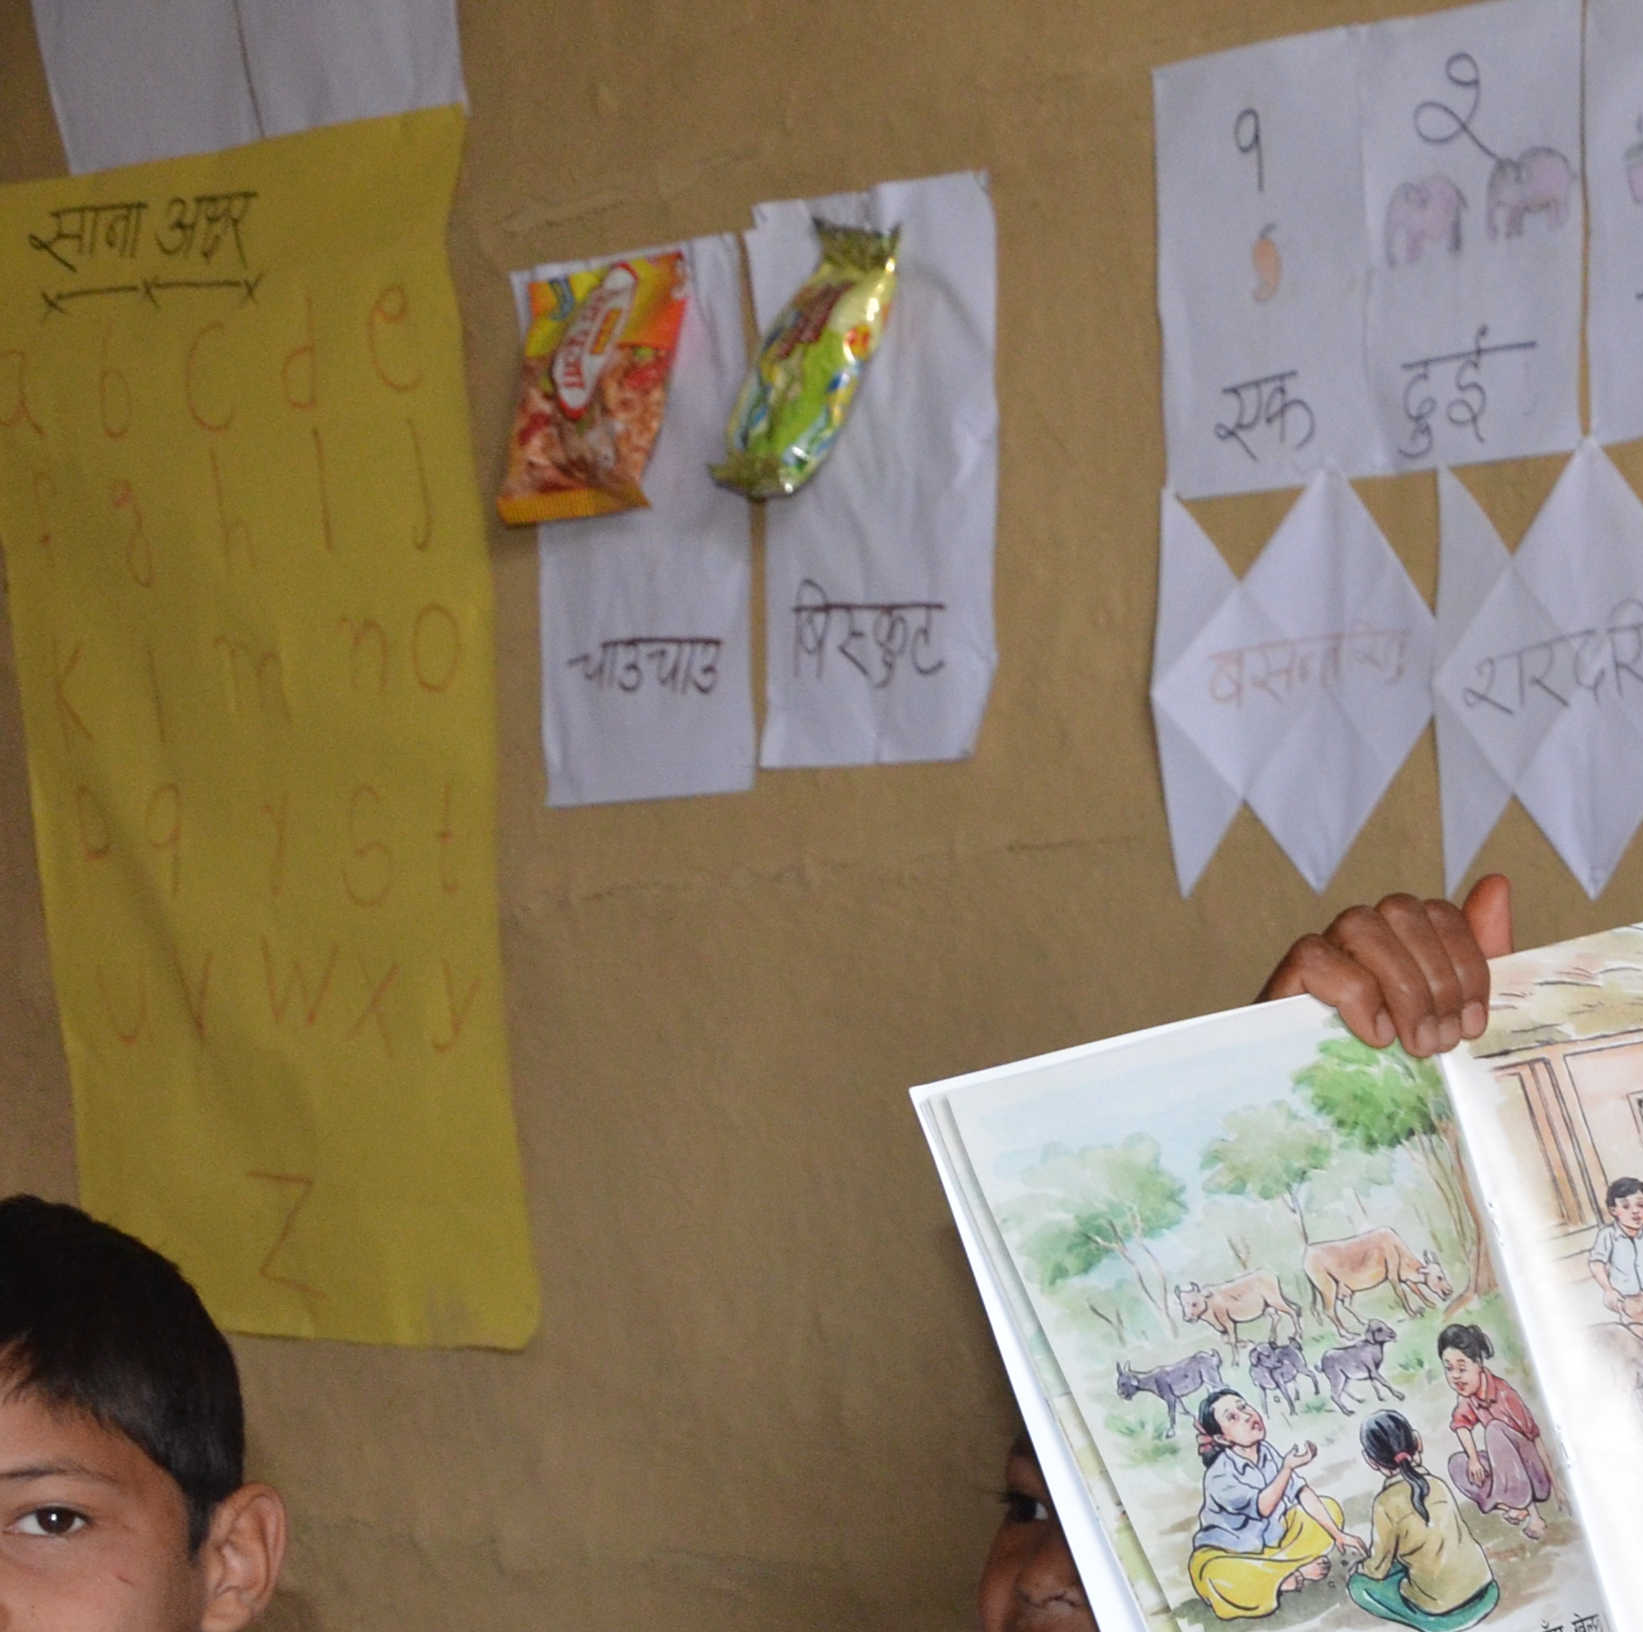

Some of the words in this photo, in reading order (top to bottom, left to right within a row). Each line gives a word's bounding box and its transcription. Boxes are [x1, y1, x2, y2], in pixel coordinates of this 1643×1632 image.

[1233, 107, 1265, 192] १
[1214, 370, 1316, 462] एक
[1398, 324, 1537, 459] दुई
